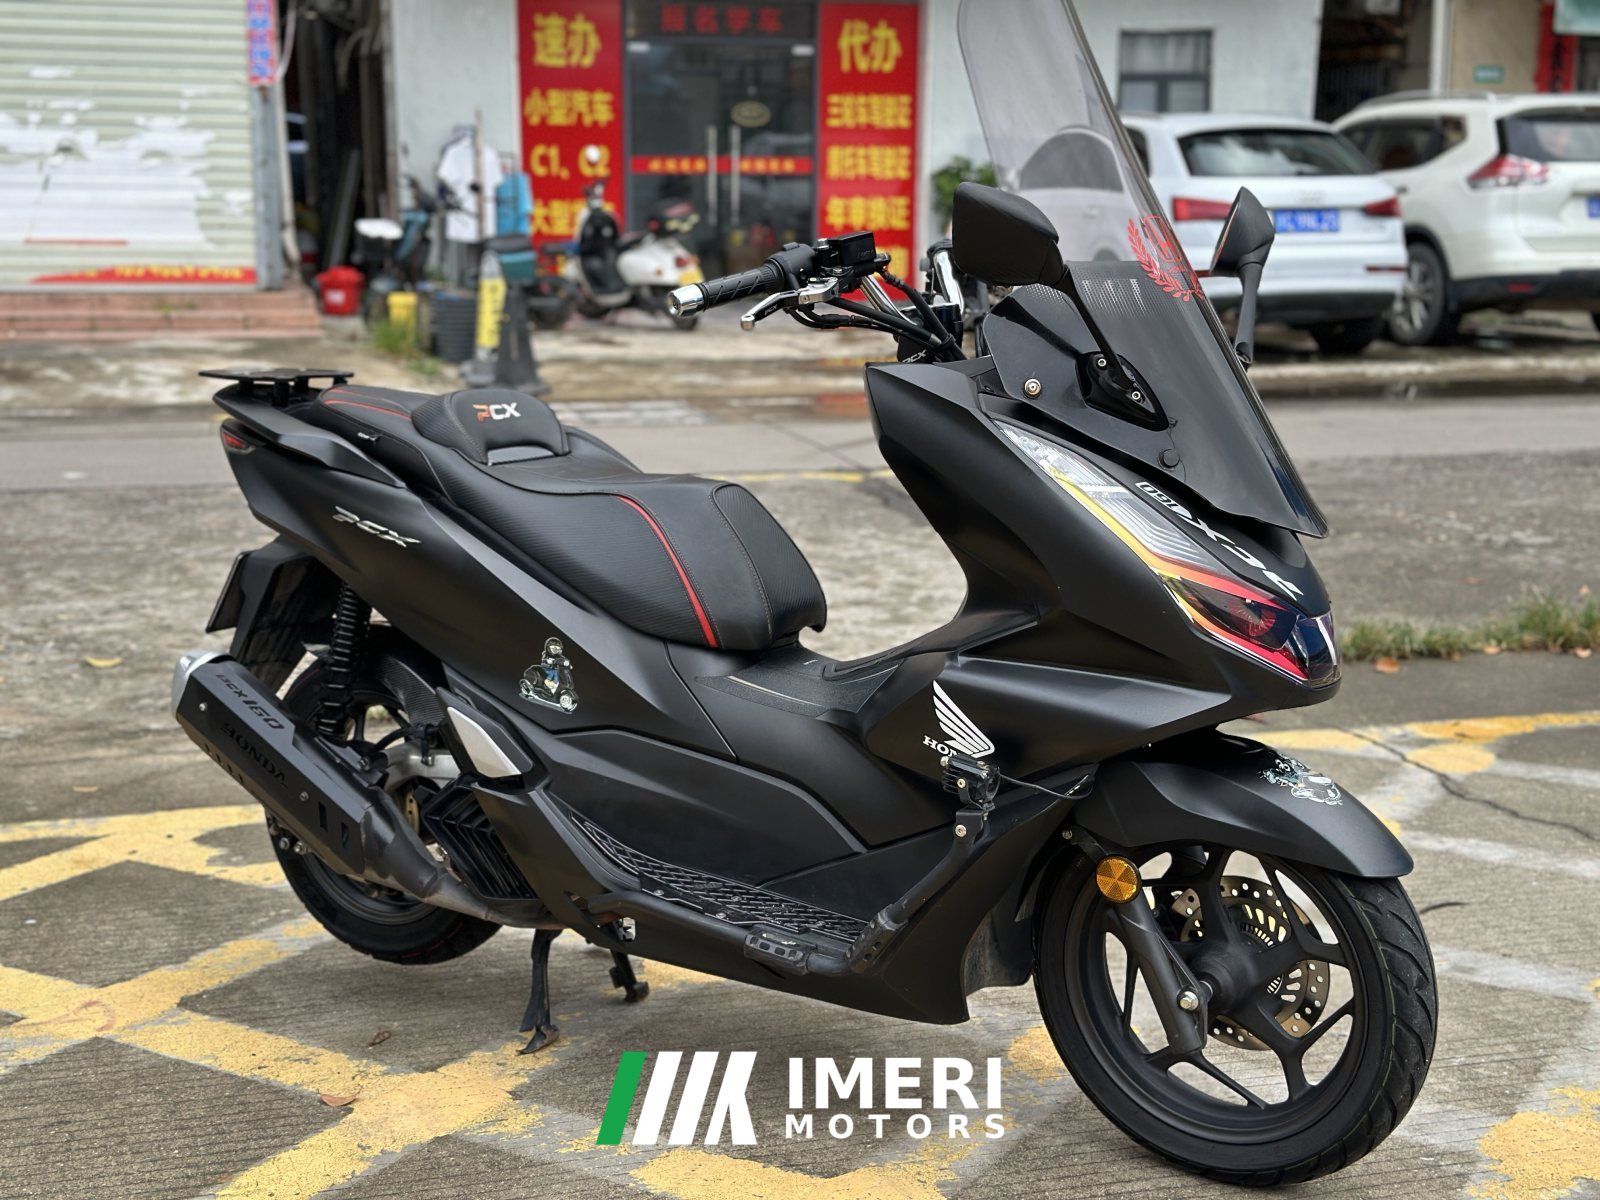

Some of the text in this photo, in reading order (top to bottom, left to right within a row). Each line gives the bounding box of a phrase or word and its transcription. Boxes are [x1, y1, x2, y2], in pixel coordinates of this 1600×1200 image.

[532, 12, 602, 68] 速办
[838, 20, 902, 74] 代办
[525, 87, 615, 127] 小型汽车
[472, 402, 521, 423] PCX
[332, 505, 422, 548] PCX
[220, 722, 289, 789] HONDA
[922, 735, 958, 757] HON
